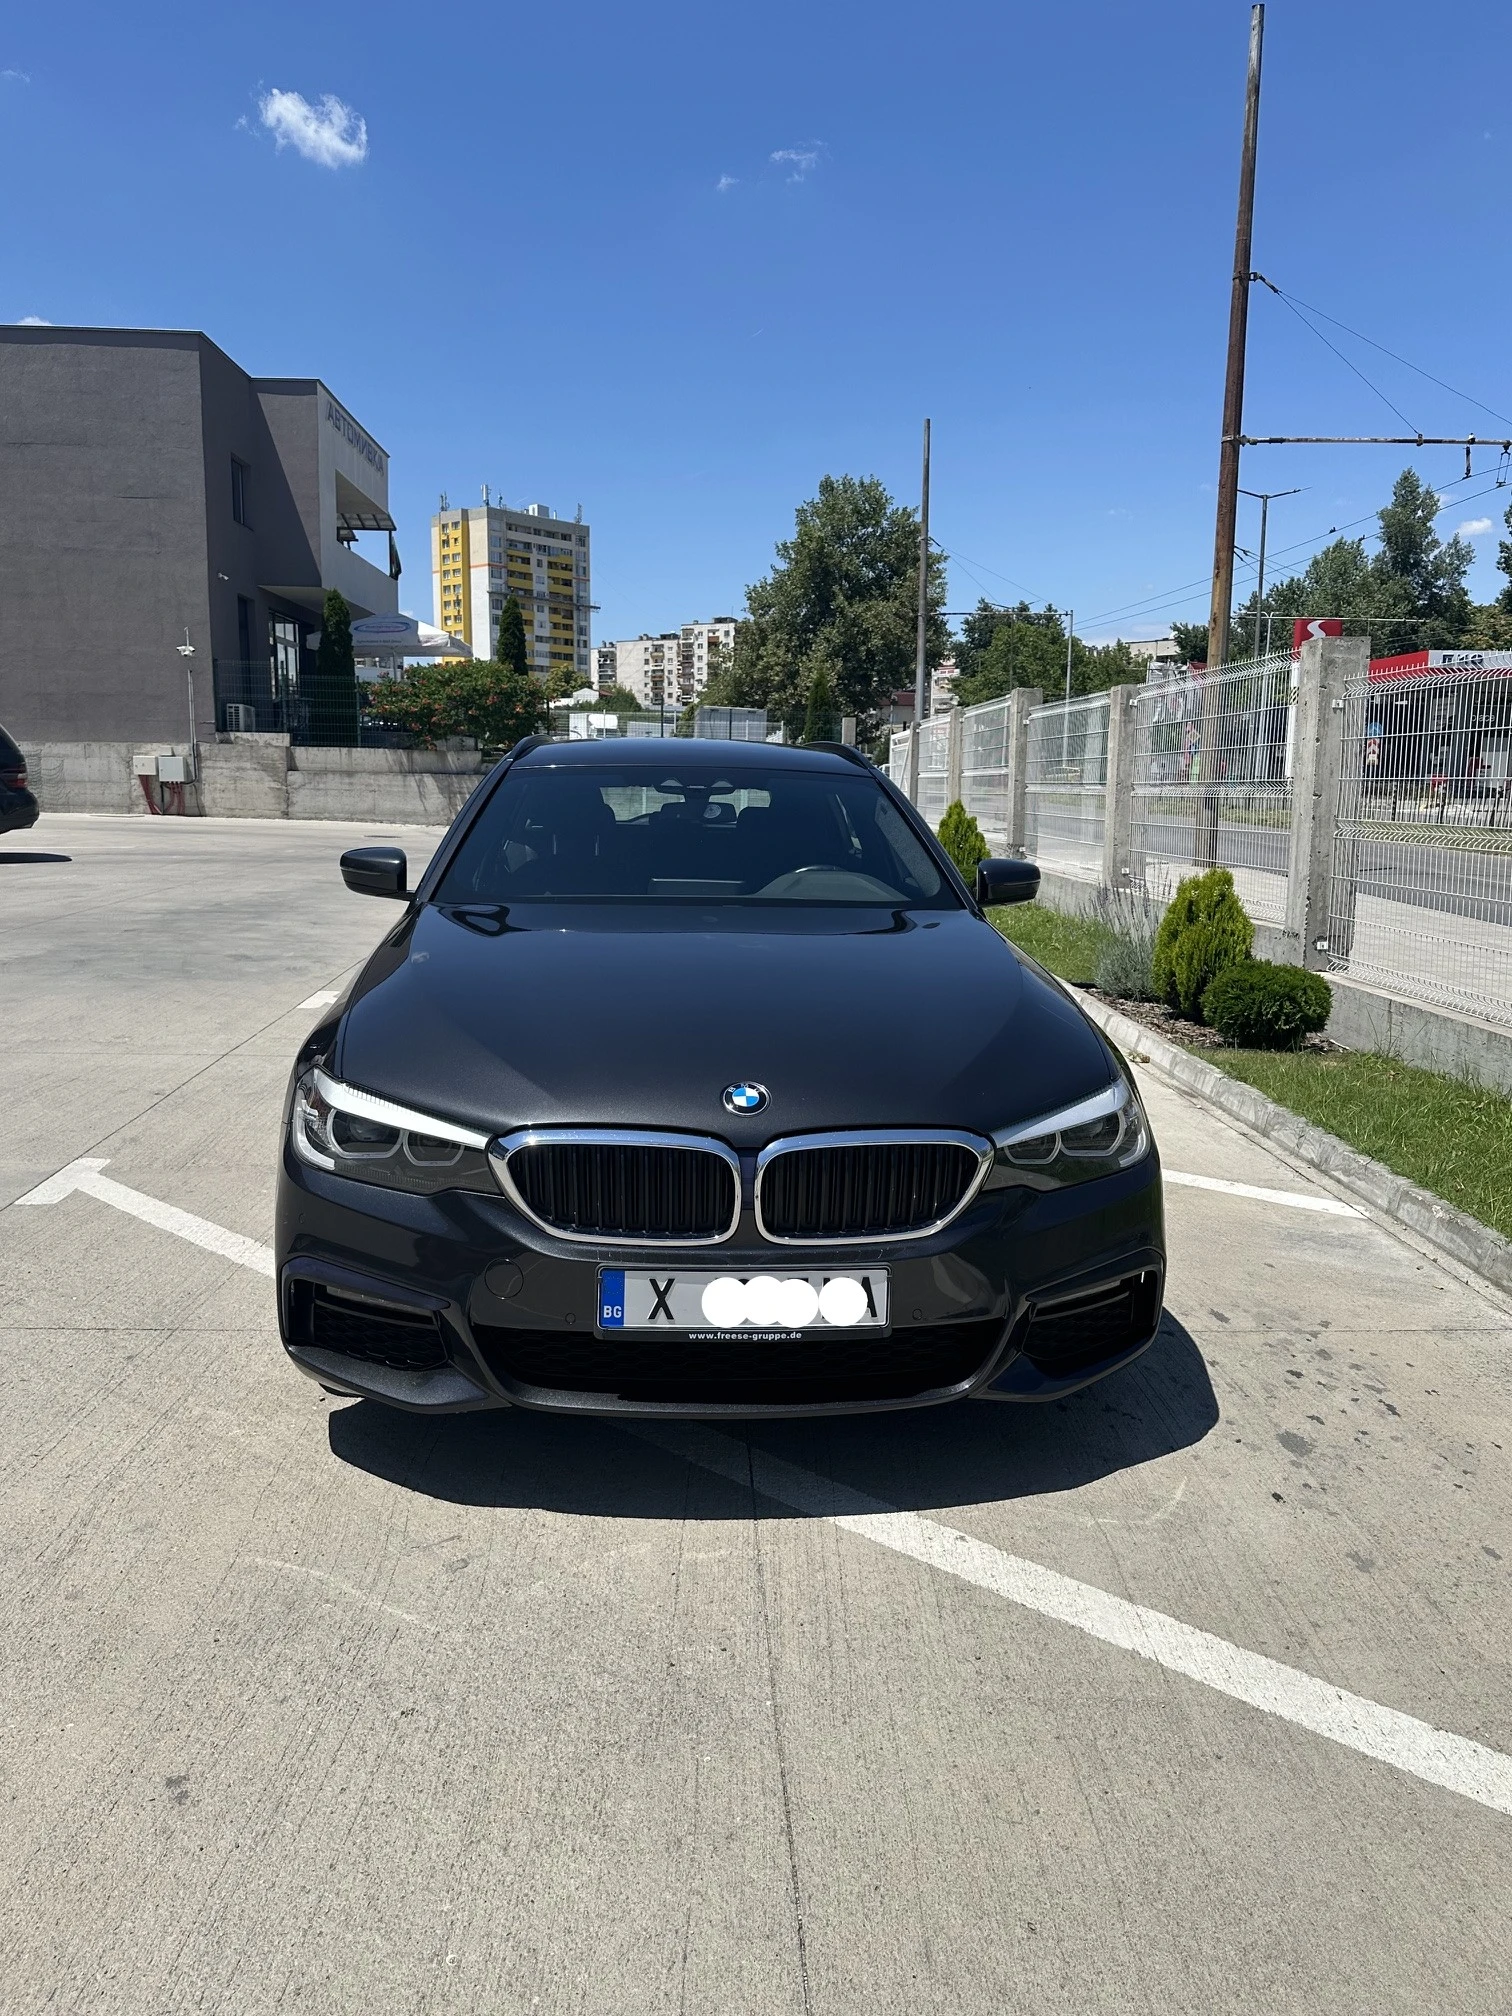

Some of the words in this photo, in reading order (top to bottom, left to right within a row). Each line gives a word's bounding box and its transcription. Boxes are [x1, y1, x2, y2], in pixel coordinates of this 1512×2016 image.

[647, 1278, 675, 1320] X
[603, 1305, 622, 1319] BG
[688, 1331, 802, 1341] www.freese-gruppe.de
